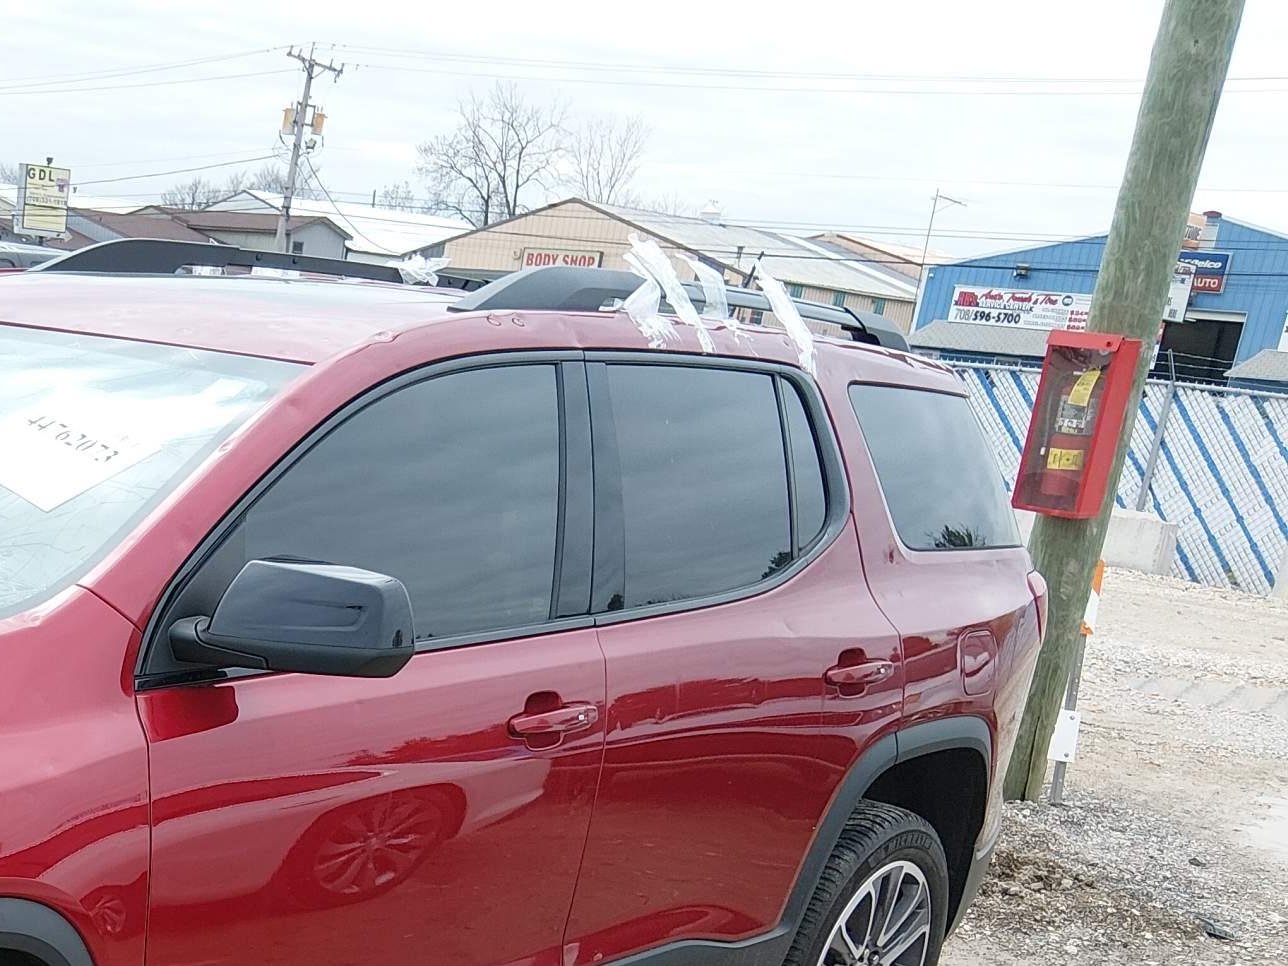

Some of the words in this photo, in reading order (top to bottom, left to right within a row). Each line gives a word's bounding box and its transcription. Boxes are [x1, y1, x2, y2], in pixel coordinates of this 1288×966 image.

[27, 167, 55, 182] GDL
[526, 253, 559, 266] BODY
[562, 254, 595, 267] SHOP
[954, 308, 1021, 325] 708/596-5700
